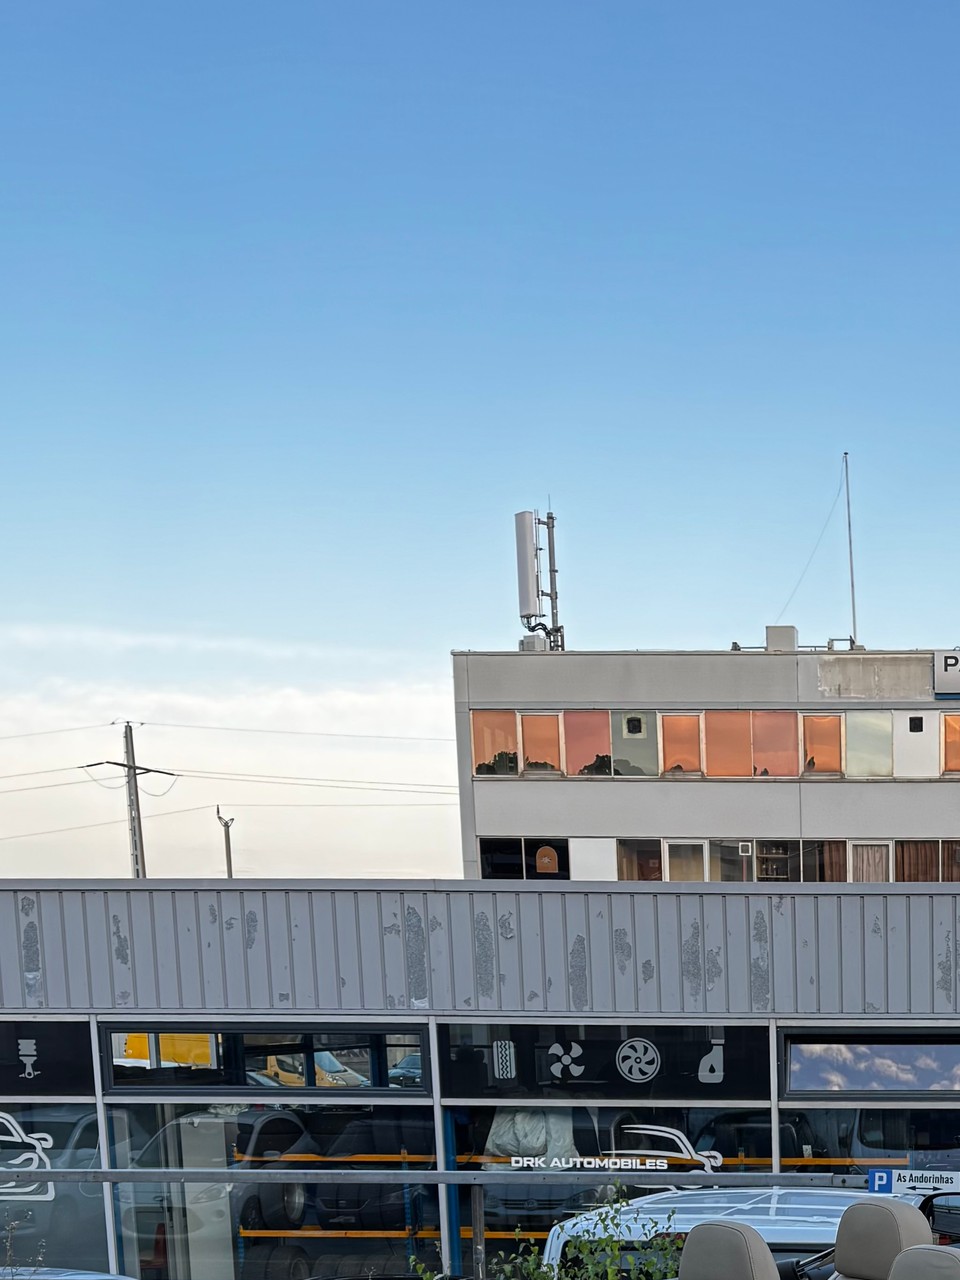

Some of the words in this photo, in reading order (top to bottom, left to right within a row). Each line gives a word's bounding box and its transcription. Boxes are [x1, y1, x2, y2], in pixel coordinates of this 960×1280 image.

[510, 1156, 546, 1168] DRK
[550, 1157, 668, 1170] AUTOMOBILES
[874, 1172, 887, 1191] P
[896, 1173, 907, 1183] As
[908, 1173, 954, 1184] Andorinhas
